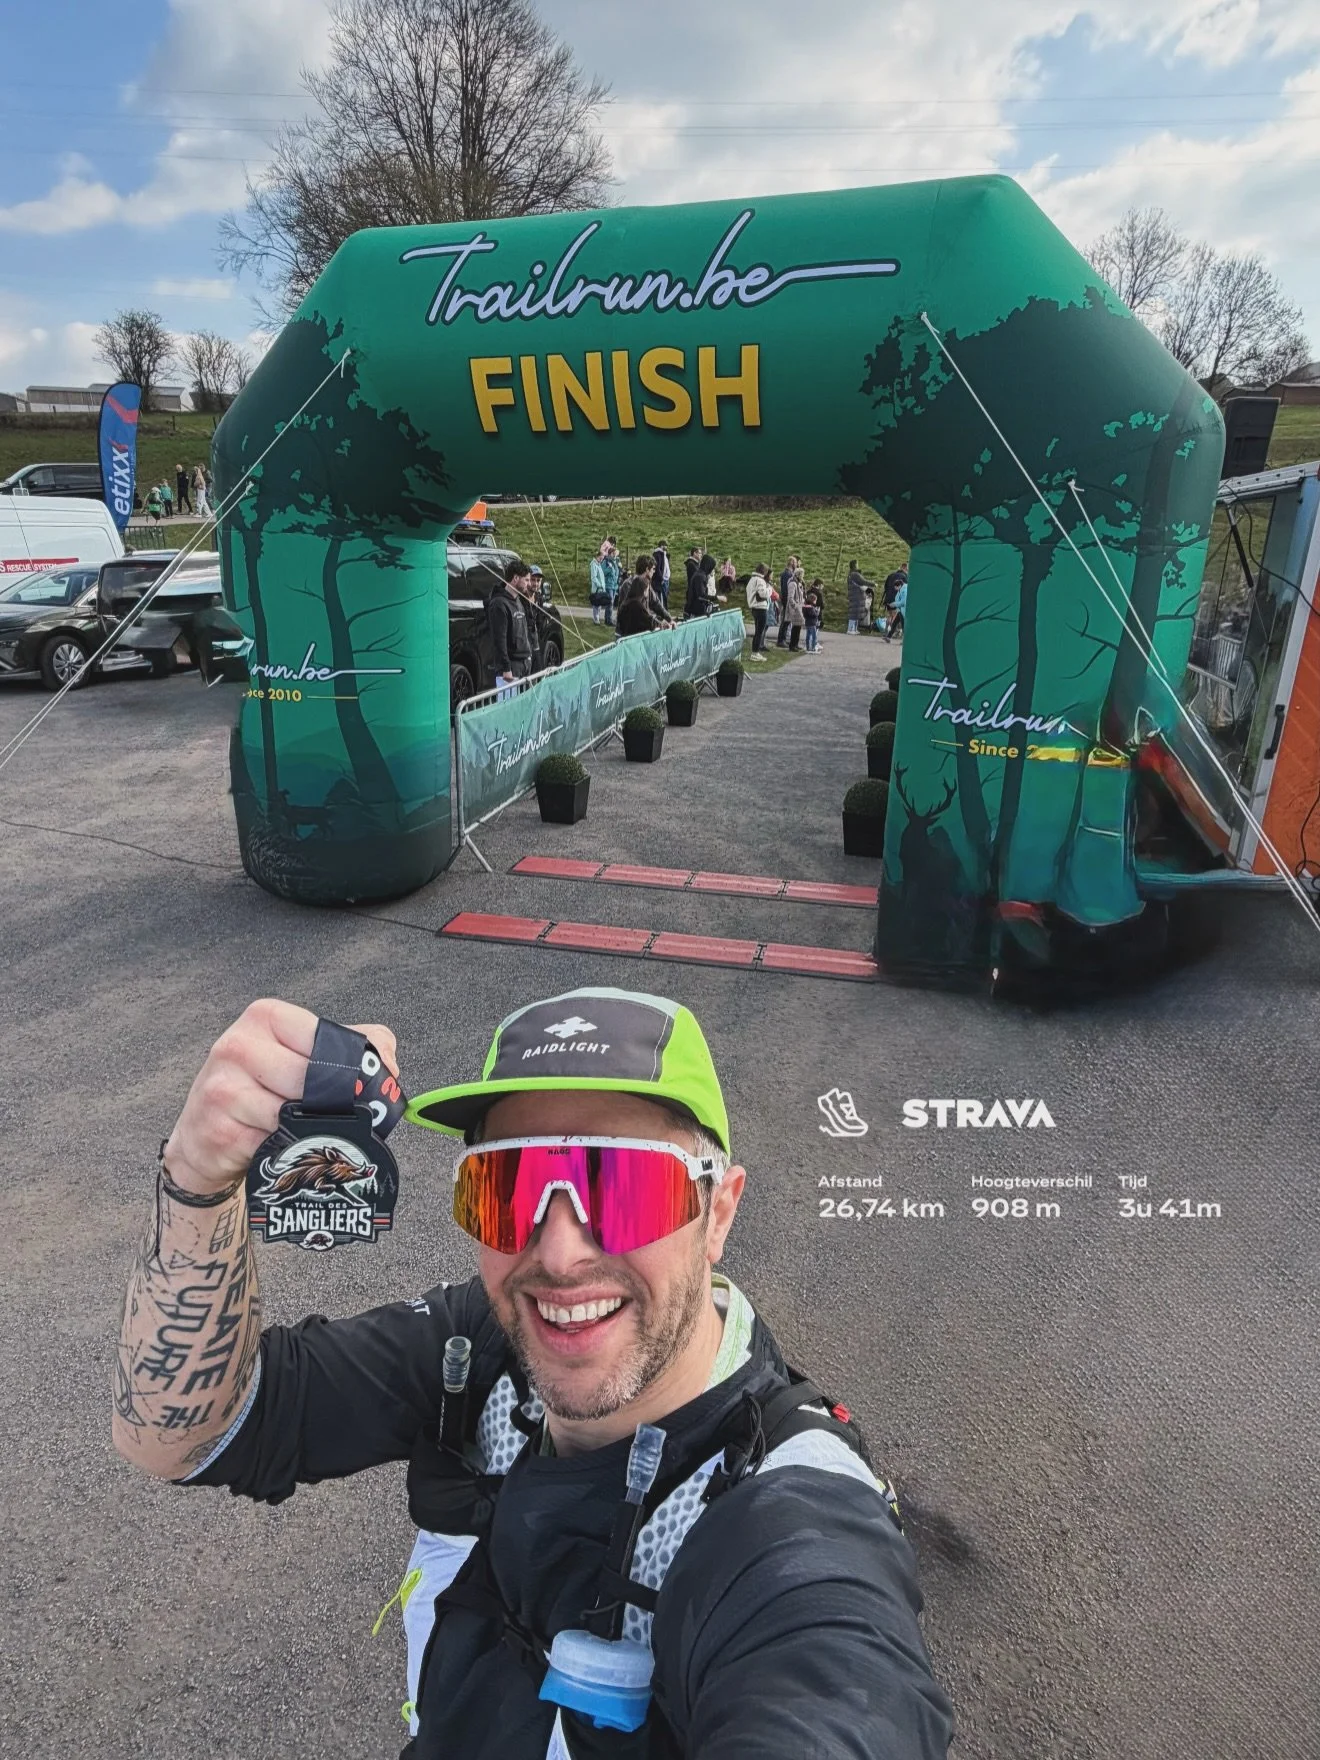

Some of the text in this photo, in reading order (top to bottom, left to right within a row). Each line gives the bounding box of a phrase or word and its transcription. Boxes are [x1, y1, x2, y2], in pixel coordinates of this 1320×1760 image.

[402, 210, 897, 324] Trailrun.be
[468, 344, 761, 433] FINISH
[109, 445, 131, 516] etixx
[6, 564, 32, 572] RESCUE
[268, 687, 301, 701] 2010
[968, 738, 1019, 759] Since
[522, 1042, 610, 1060] RAIDLIGHT
[268, 1206, 372, 1237] SANGLIERS
[133, 1259, 229, 1392] FUTURE
[152, 1399, 215, 1429] THE
